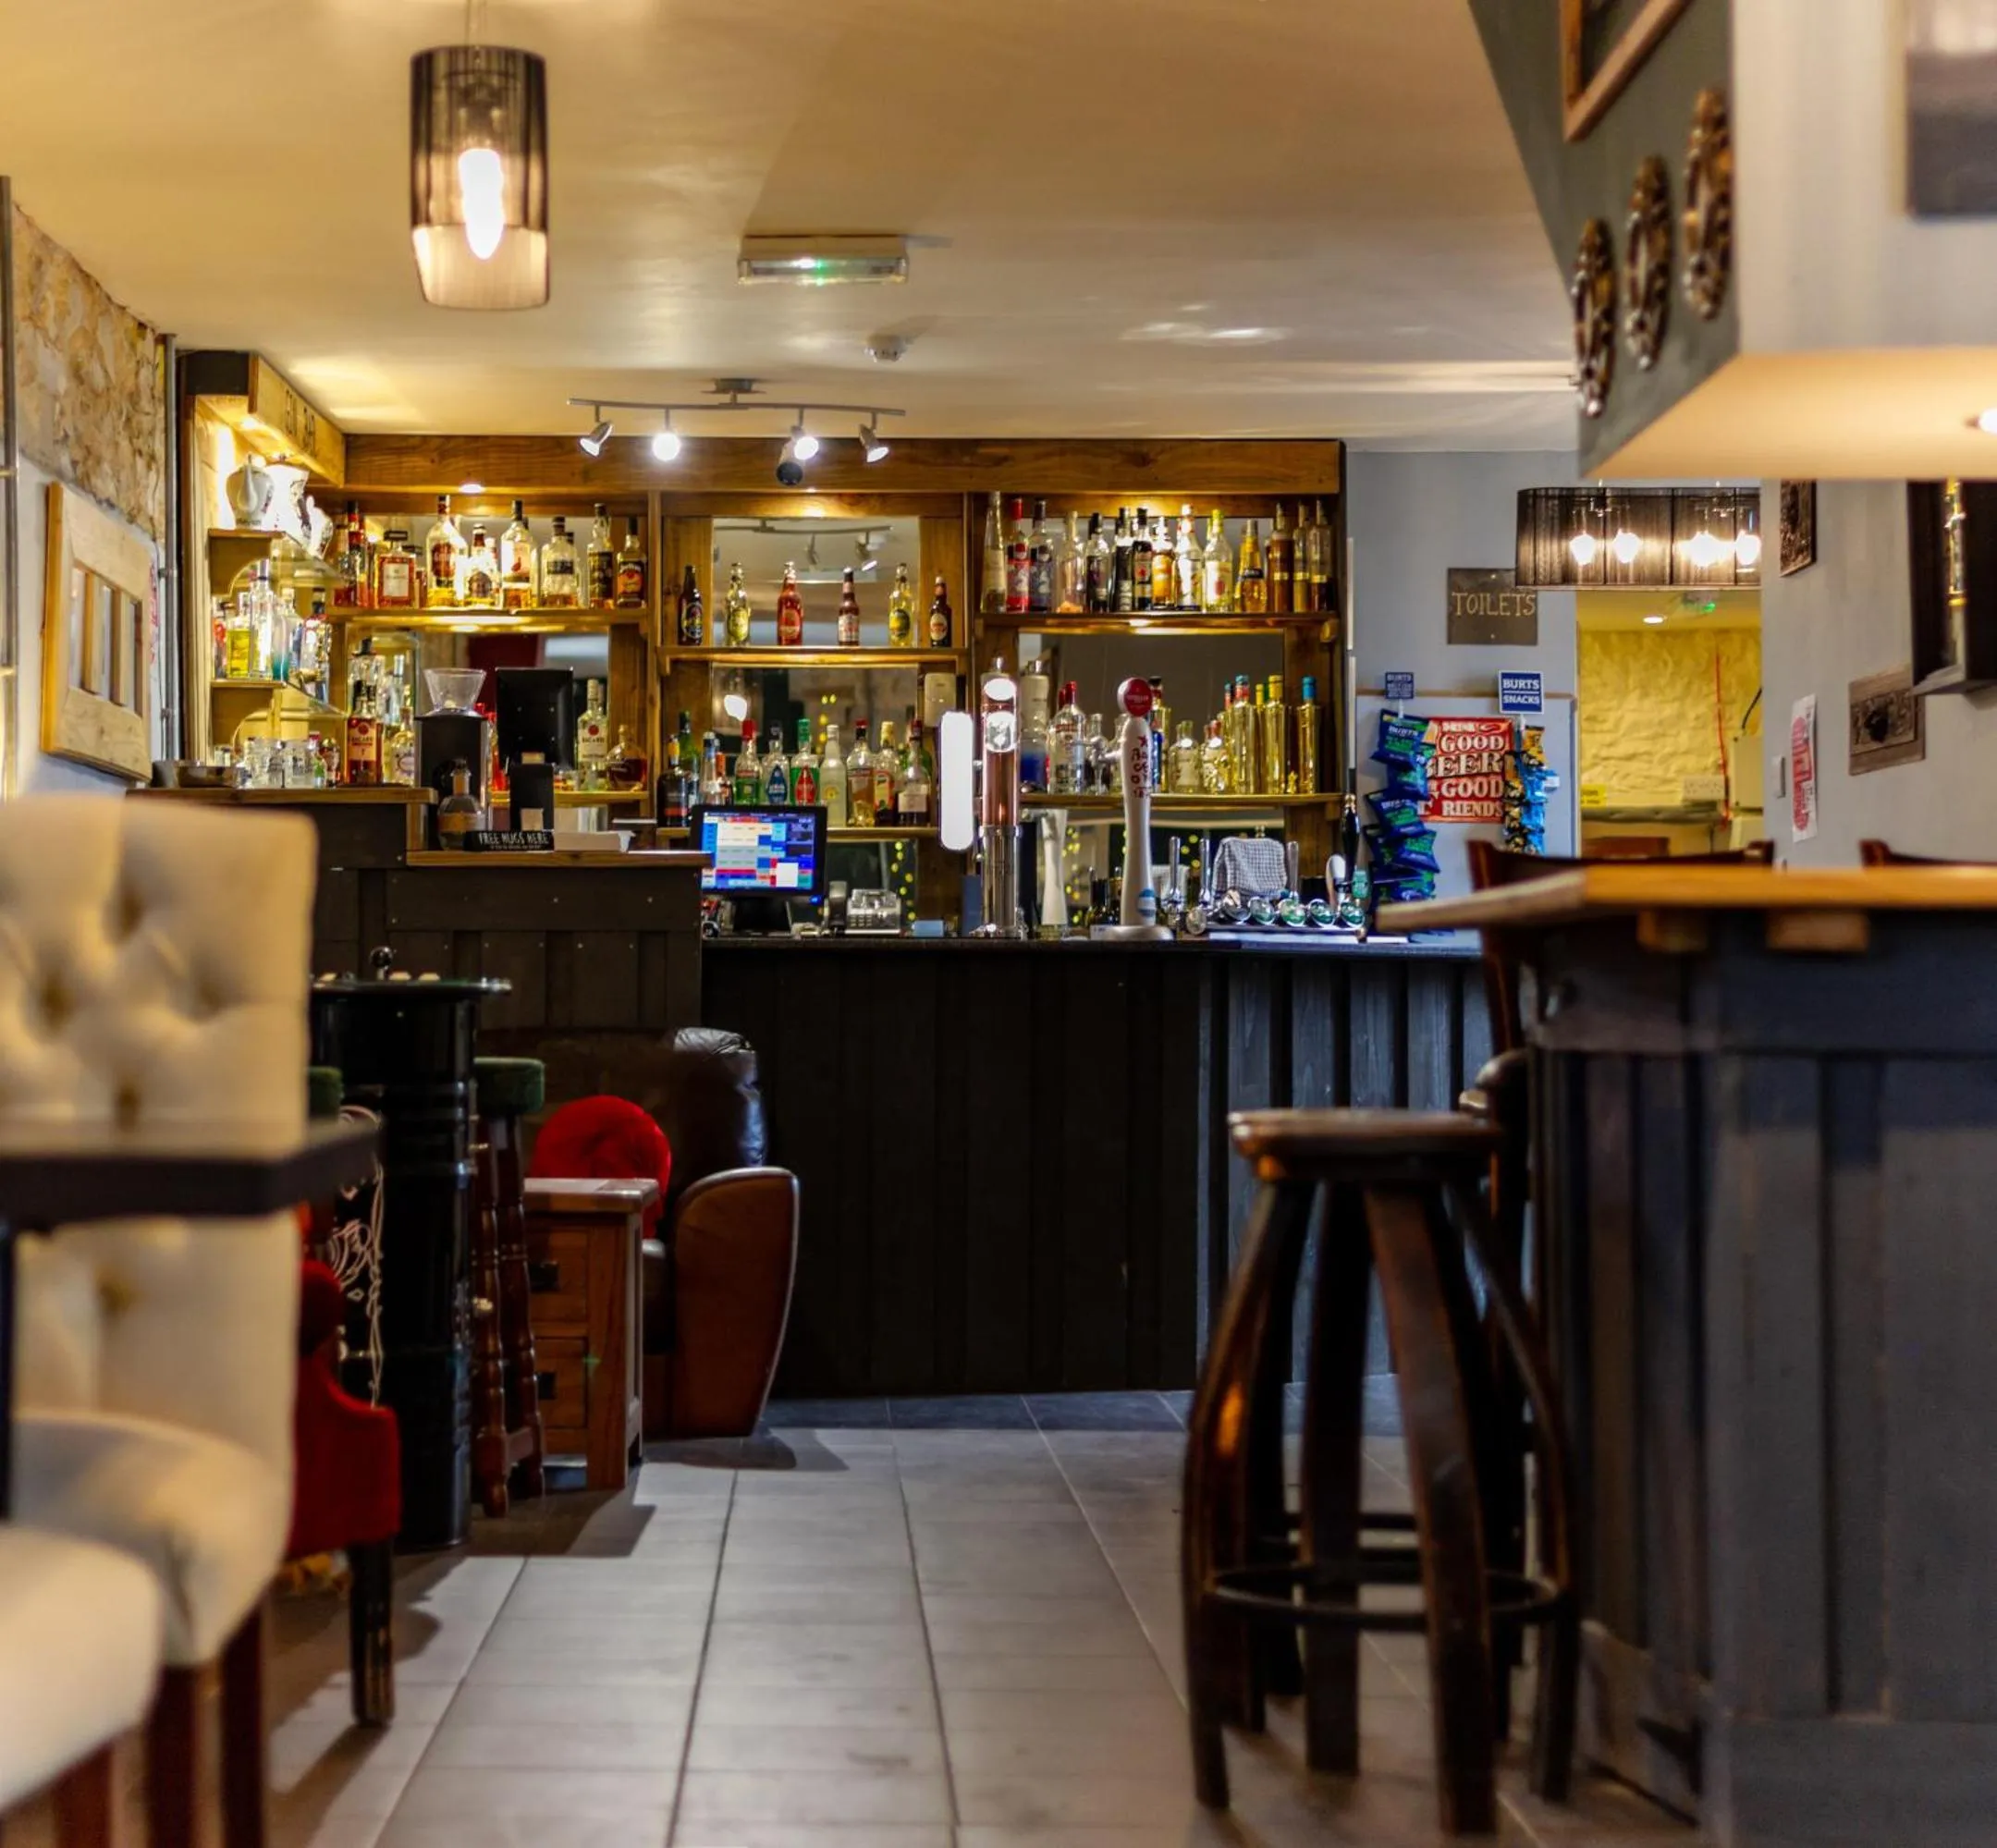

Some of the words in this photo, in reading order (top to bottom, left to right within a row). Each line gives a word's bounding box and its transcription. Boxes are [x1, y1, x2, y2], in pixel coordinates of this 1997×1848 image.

[1452, 591, 1537, 617] TOILETS
[1502, 679, 1540, 690] BURTS
[1502, 694, 1540, 705] SNACKS
[1440, 735, 1505, 753] GOOD
[1440, 777, 1504, 799] GOOD
